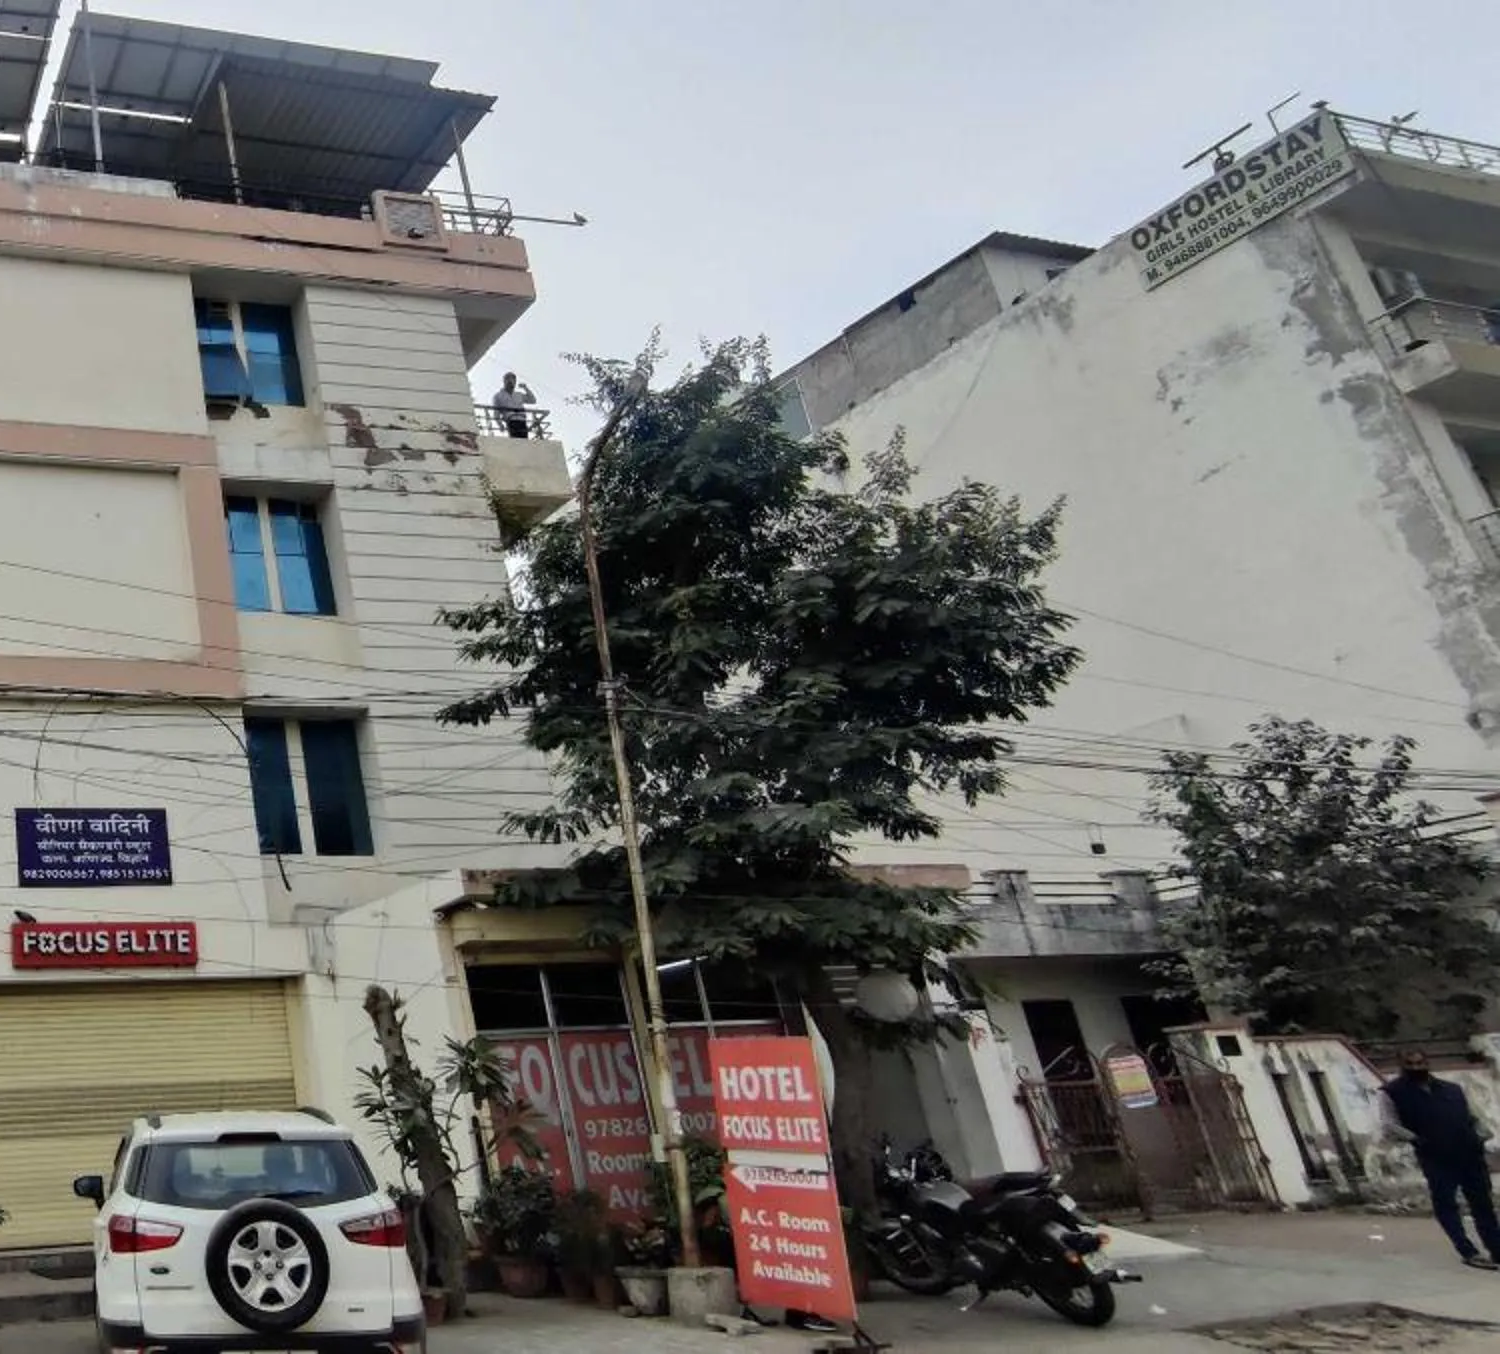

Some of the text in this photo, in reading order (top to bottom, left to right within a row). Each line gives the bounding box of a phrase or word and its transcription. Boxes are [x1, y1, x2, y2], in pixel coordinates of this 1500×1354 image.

[1131, 115, 1323, 251] OXFORDSTAY
[1146, 147, 1325, 263] GIRLS HOSTEL & LIBRARY
[33, 813, 152, 836] वीणा वादिनी
[23, 930, 190, 953] FOCUS ELITE
[719, 1066, 813, 1101] HOTEL
[722, 1115, 822, 1143] FOCUS ELITE
[741, 1207, 831, 1233] A.C. Room
[750, 1233, 828, 1260] 24 Hours
[753, 1260, 833, 1288] Available
